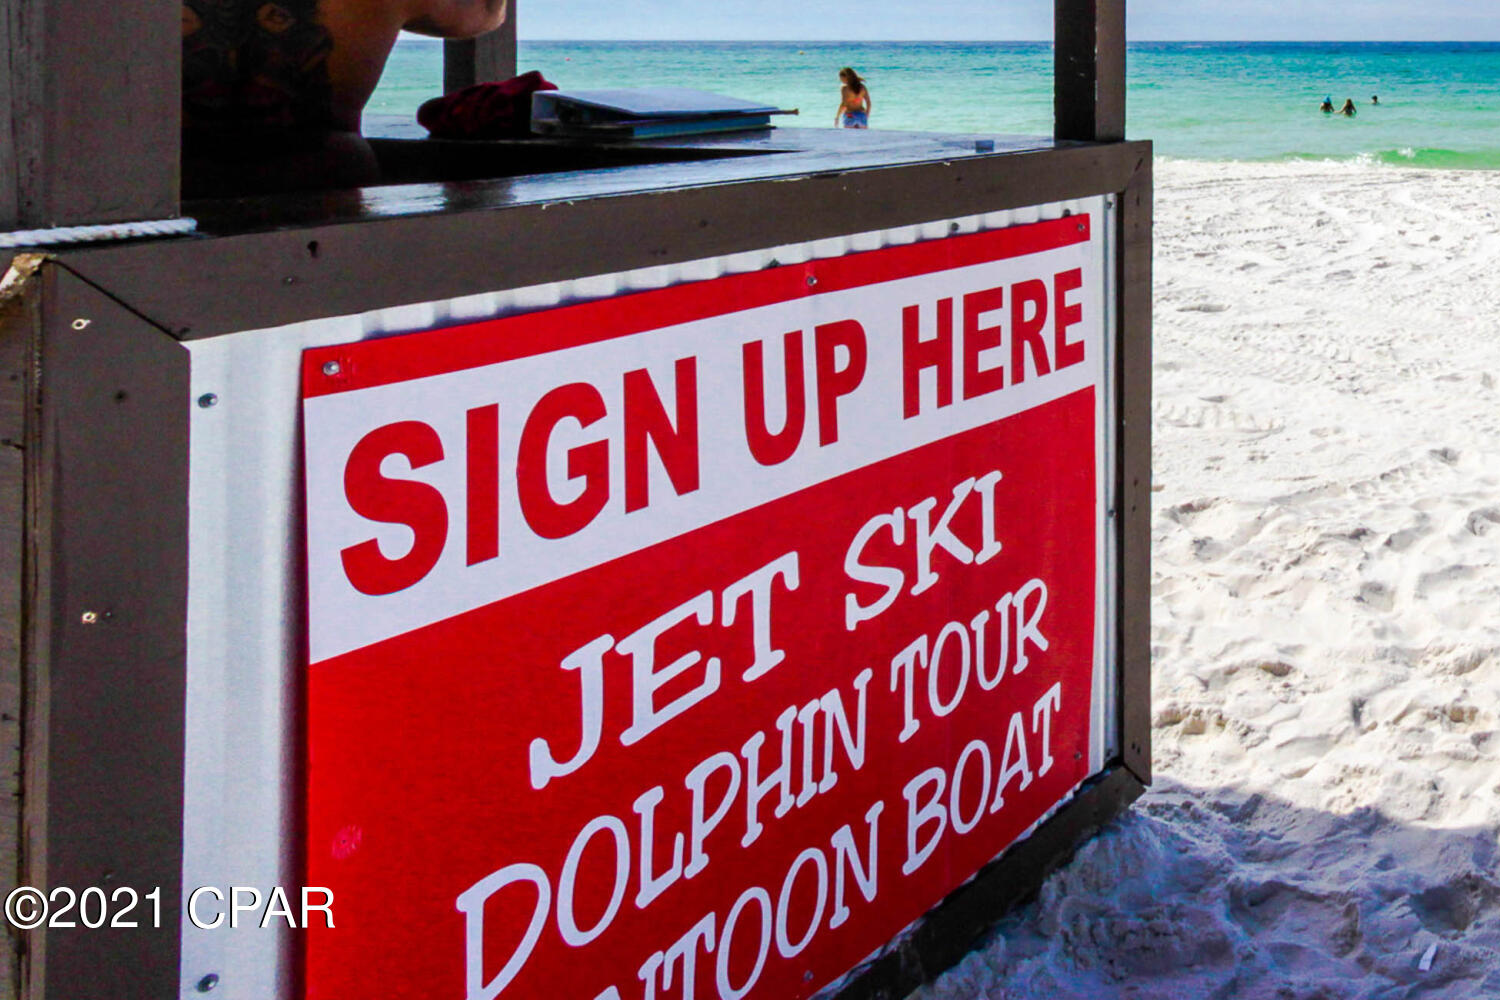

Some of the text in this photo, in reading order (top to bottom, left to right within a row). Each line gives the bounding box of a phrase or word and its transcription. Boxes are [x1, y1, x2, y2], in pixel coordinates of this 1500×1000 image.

[339, 267, 1086, 597] SIGN UP HERE
[455, 578, 1049, 1000] DOLPHIN TOUR
[529, 470, 1003, 791] JET SKI
[902, 681, 1062, 876] BOAT
